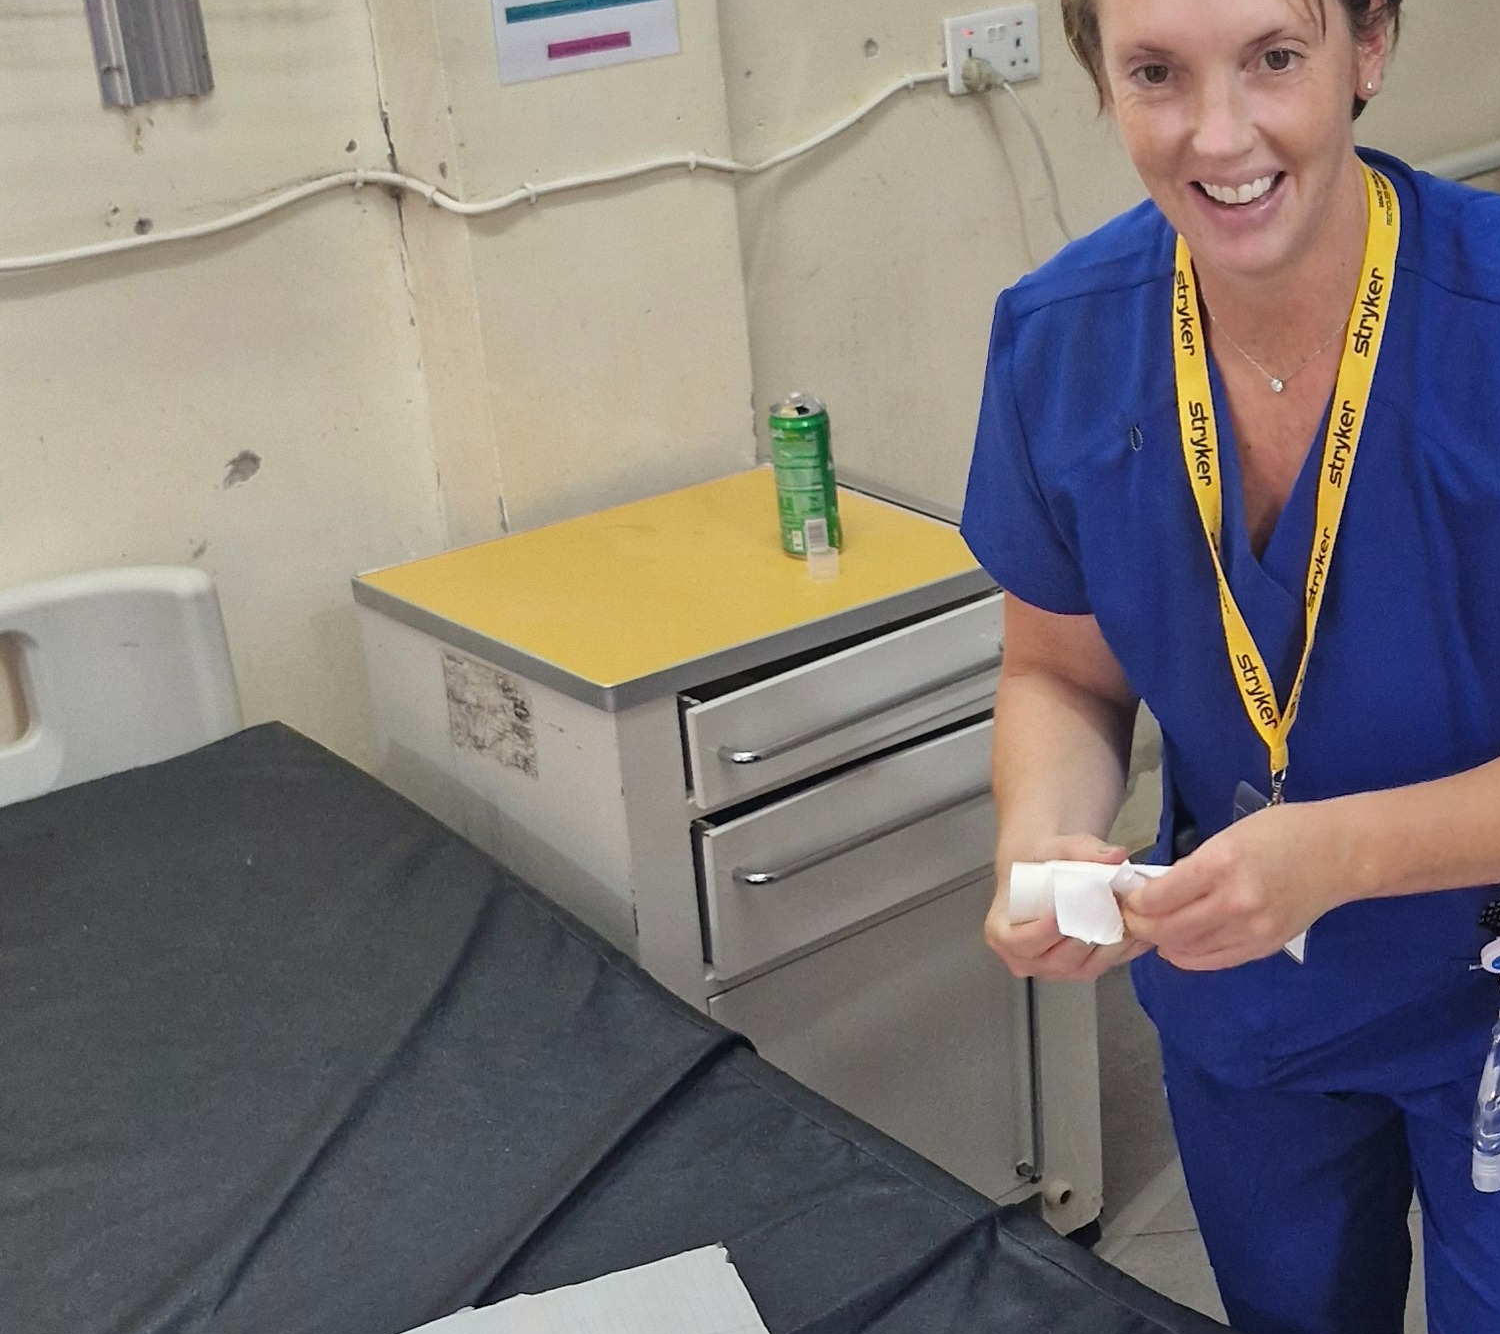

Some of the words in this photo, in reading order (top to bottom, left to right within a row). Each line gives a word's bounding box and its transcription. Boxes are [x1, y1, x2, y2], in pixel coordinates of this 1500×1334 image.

[1176, 269, 1196, 357] stryker
[1353, 267, 1385, 358] stryker
[1188, 400, 1212, 487] stryker
[1328, 399, 1357, 489] stryker
[1306, 526, 1331, 614] stryker
[1235, 652, 1278, 730] stryker
